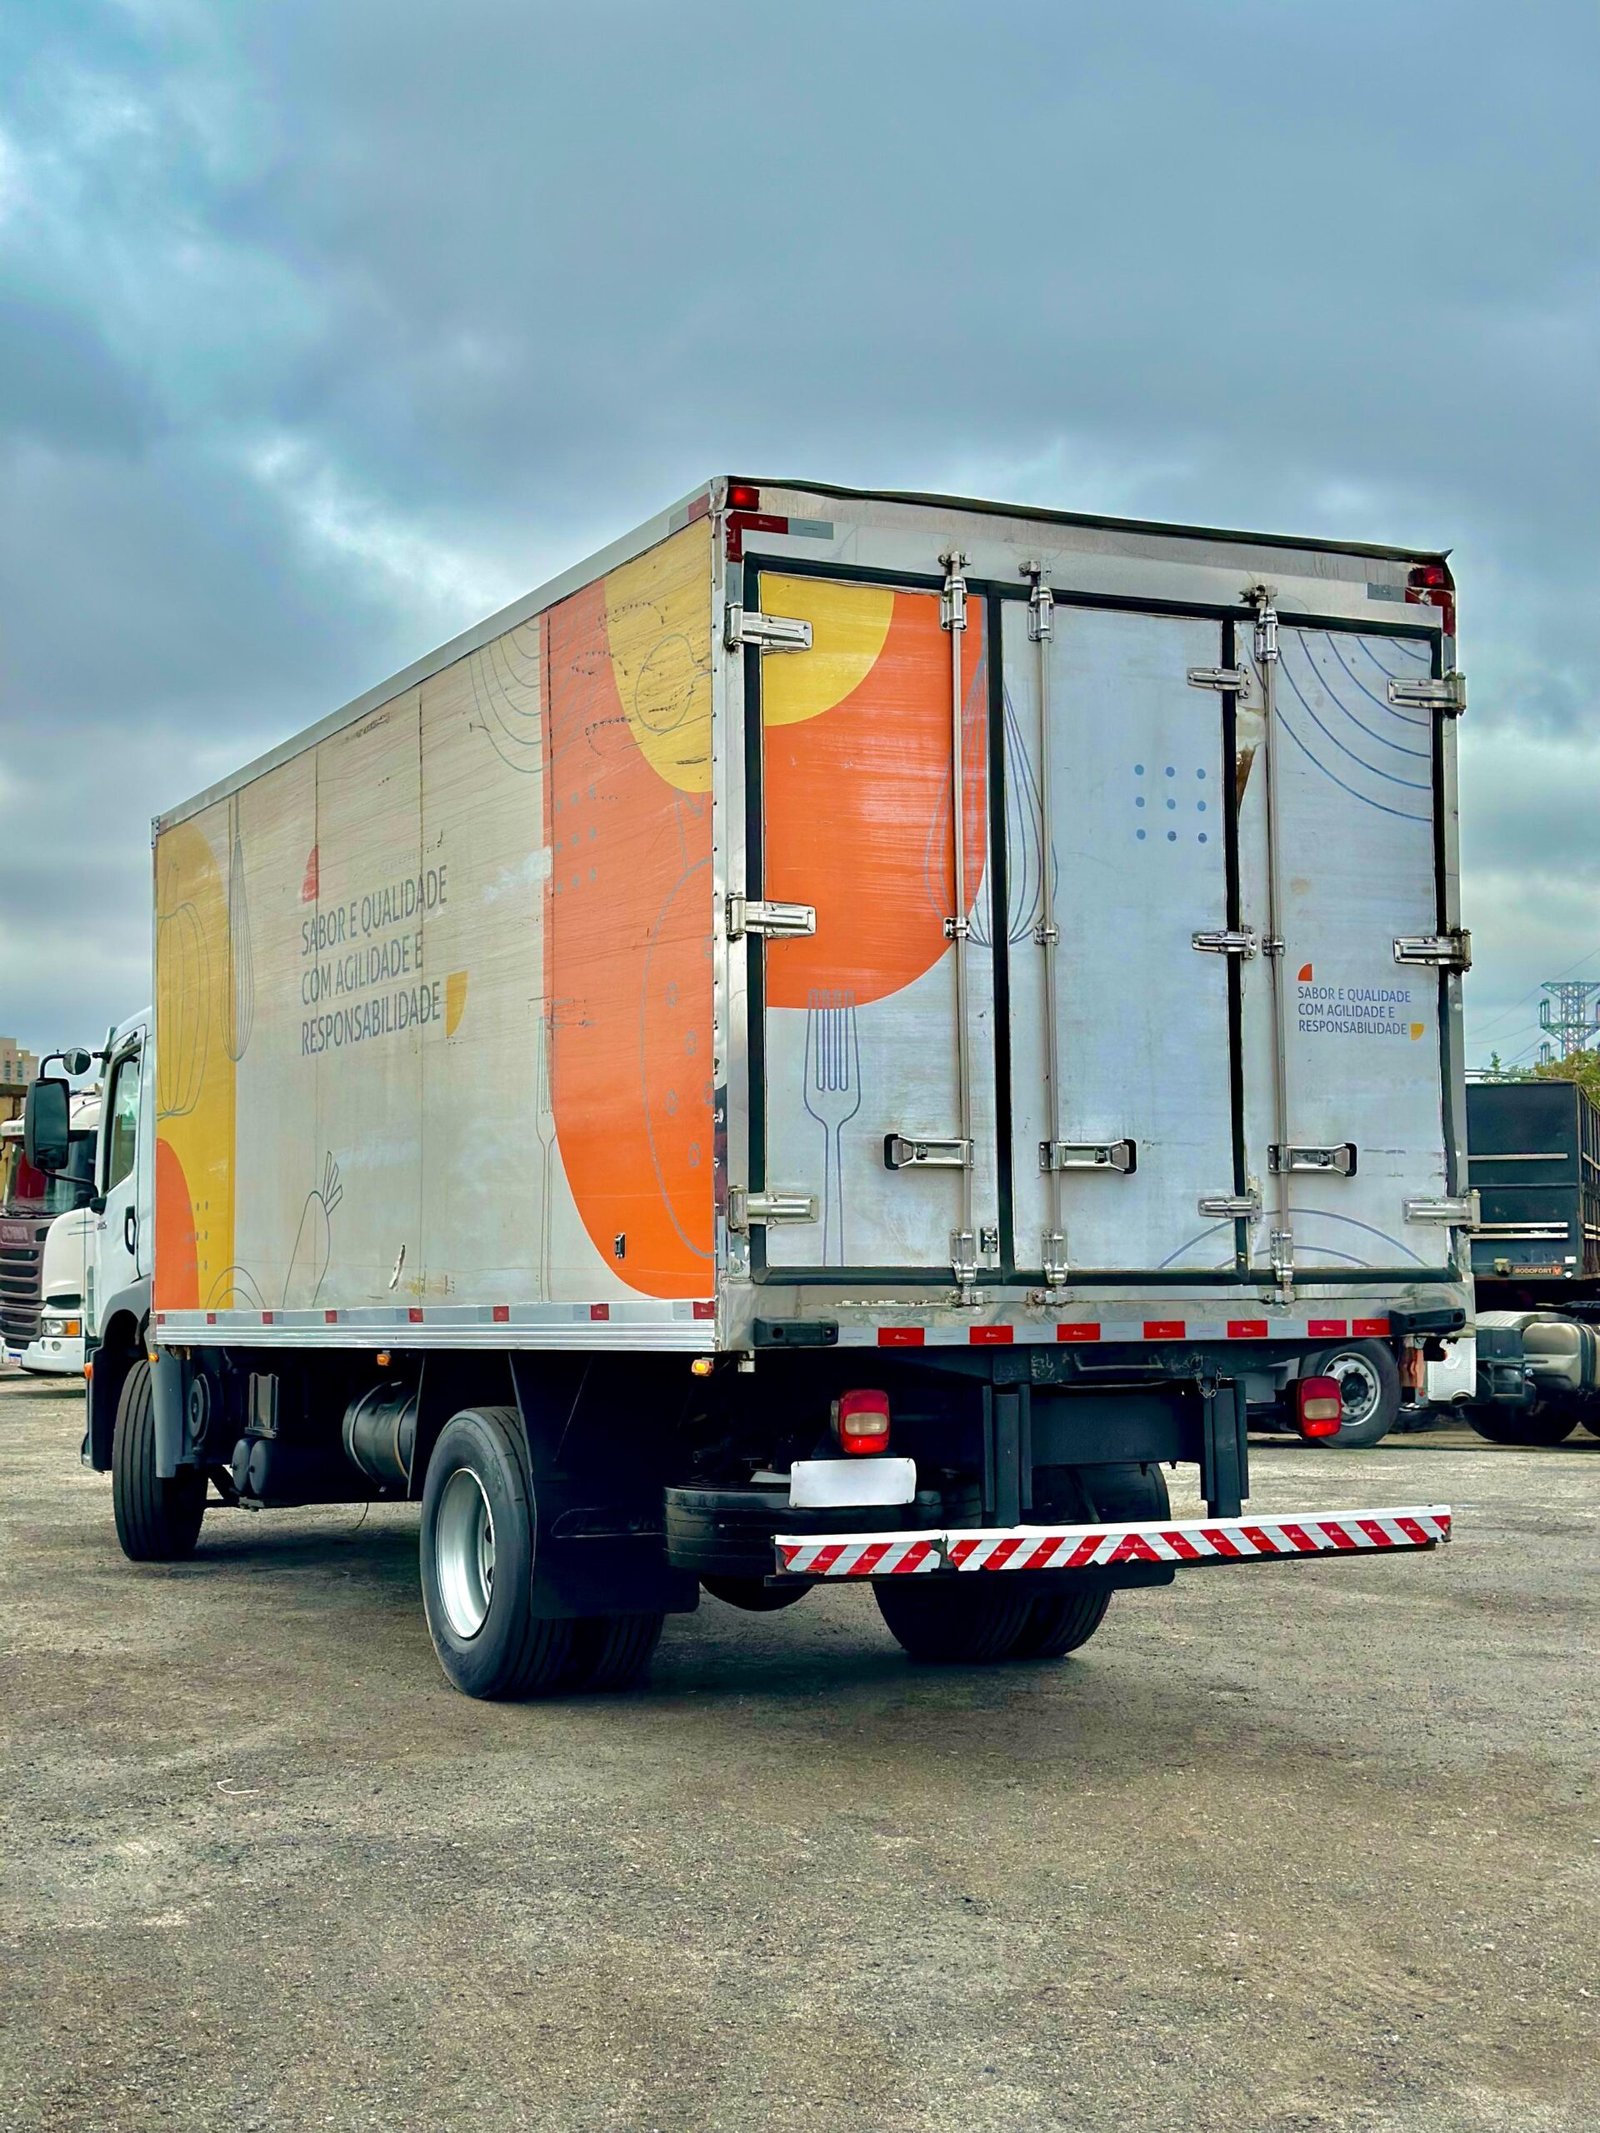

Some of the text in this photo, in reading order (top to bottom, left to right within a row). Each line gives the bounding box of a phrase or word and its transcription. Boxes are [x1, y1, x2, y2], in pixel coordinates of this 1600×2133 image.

[301, 865, 448, 956] SABOR E QUALIDADE
[301, 930, 424, 1005] COM AGILIDADE E
[1298, 986, 1411, 1003] SABOR E QUALIDADE
[1298, 1003, 1395, 1018] COM AGILIDADE E
[301, 981, 441, 1056] RESPONSABILIDADE
[1298, 1019, 1408, 1035] RESPONSABILIDADE
